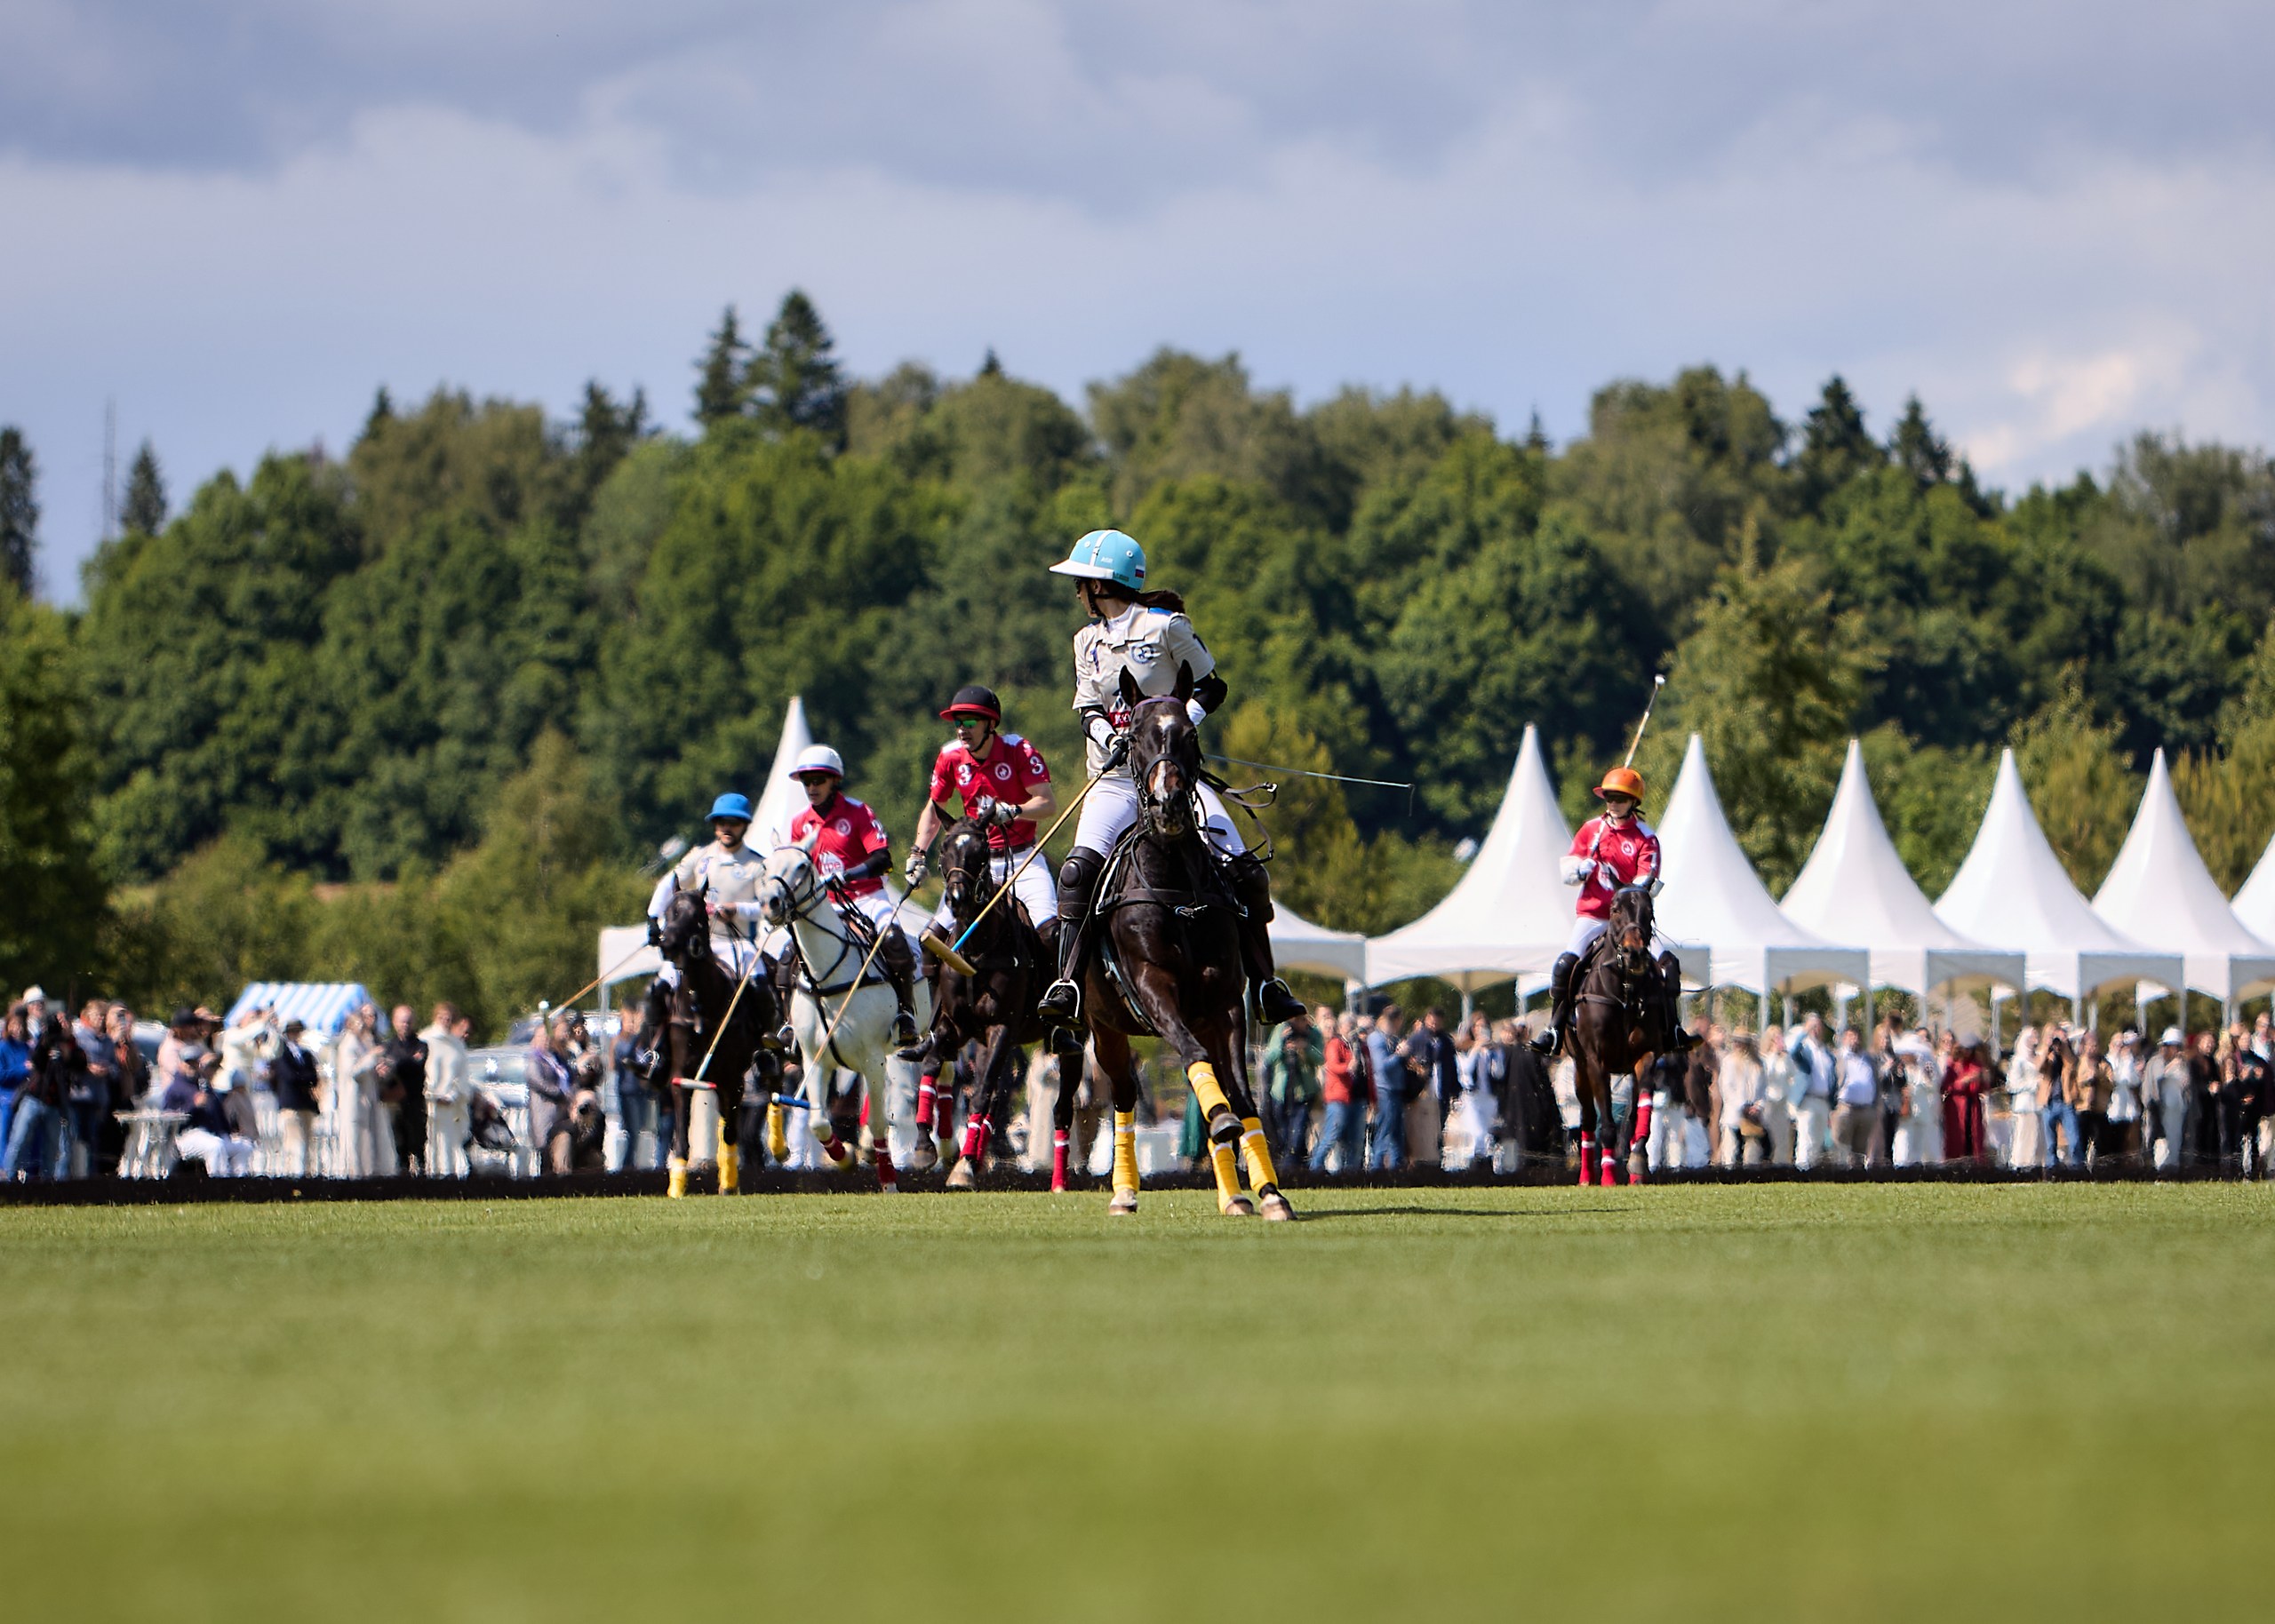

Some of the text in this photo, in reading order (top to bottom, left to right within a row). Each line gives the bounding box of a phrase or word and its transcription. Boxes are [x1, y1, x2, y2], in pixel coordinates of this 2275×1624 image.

[958, 764, 972, 786] 3
[1029, 756, 1044, 775] 3
[698, 857, 710, 874] 3
